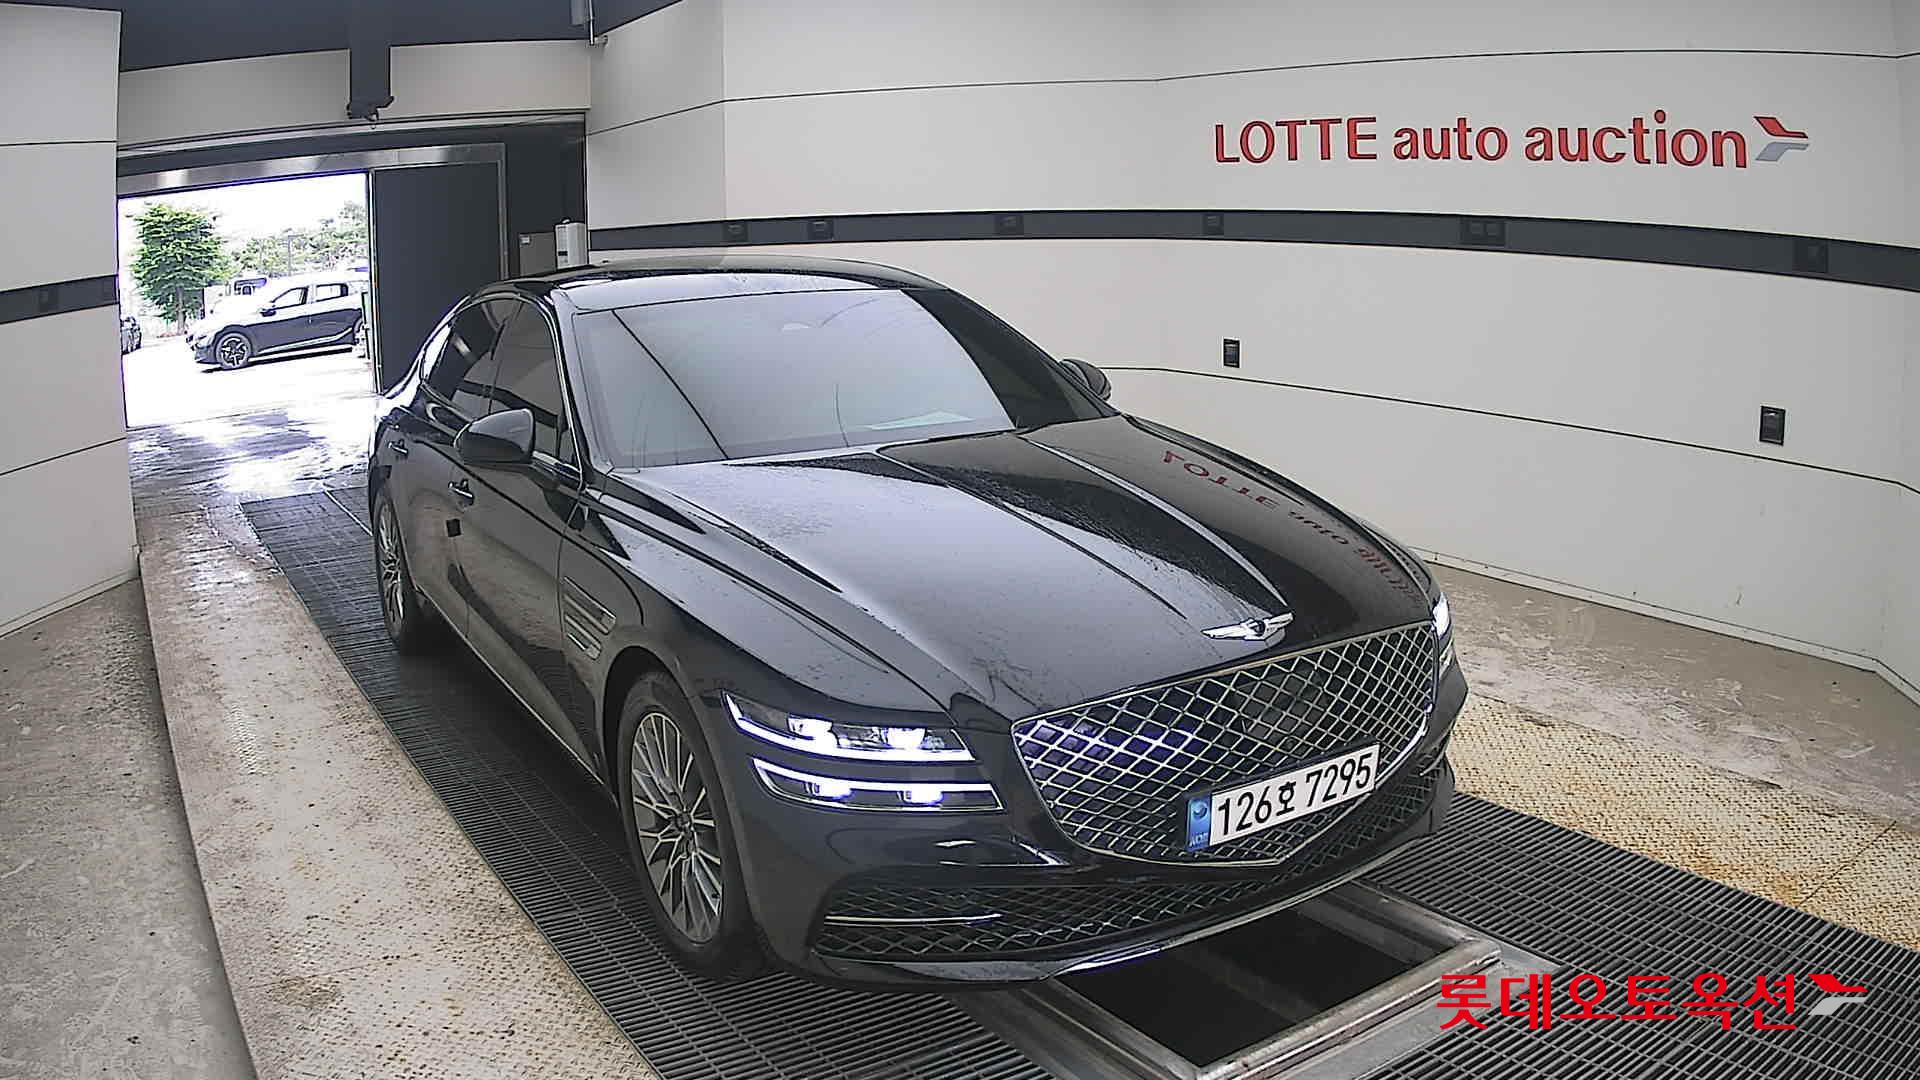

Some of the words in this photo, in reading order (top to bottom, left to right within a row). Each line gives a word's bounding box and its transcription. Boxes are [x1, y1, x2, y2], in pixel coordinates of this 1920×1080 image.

[1214, 116, 1378, 164] LOTTE
[1392, 116, 1511, 162] auto
[1523, 109, 1749, 169] auction
[1217, 781, 1297, 836] 126호
[1305, 753, 1372, 807] 7295
